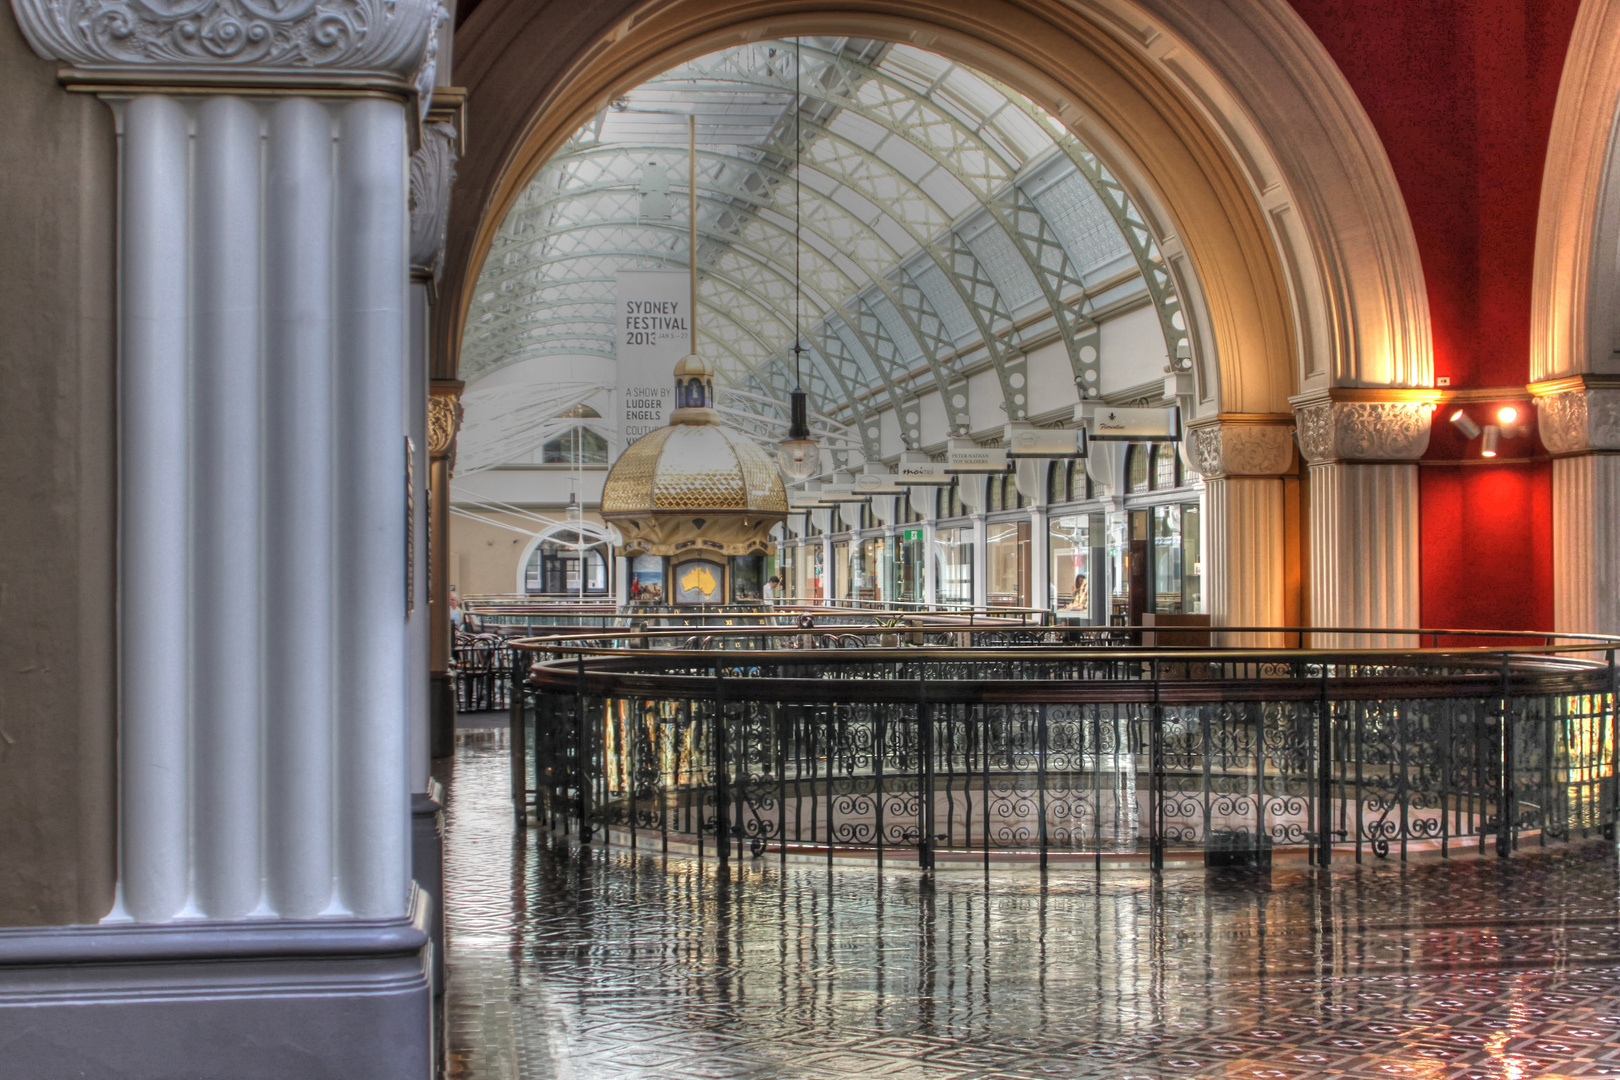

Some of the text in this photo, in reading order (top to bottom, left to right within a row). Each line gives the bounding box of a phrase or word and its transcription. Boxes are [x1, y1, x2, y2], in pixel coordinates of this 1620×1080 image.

[626, 301, 678, 314] SYDNEY
[626, 317, 688, 330] FESTIVAL
[626, 332, 656, 345] 2013
[626, 388, 671, 397] A SHOW BY
[626, 400, 662, 408] LUDGER
[626, 411, 661, 420] ENGELS
